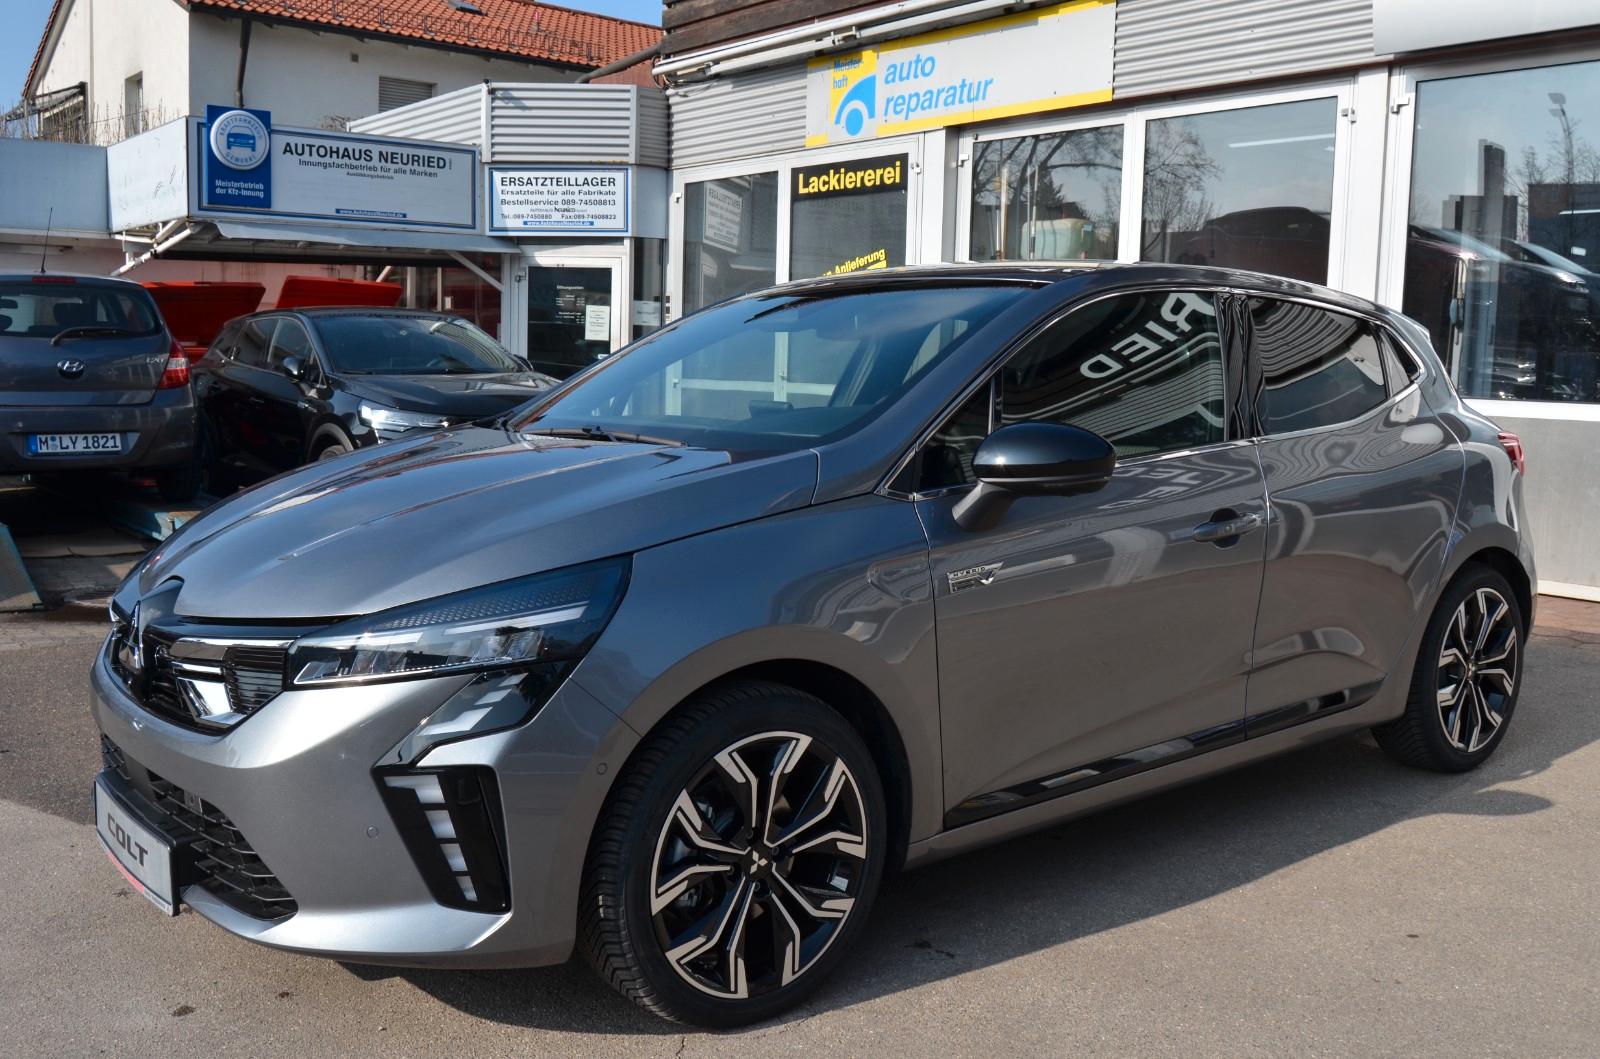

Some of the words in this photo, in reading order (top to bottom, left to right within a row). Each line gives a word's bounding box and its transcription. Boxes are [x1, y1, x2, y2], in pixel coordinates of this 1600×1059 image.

[884, 53, 936, 84] auto
[883, 78, 993, 120] reparatur
[282, 142, 373, 162] AUTOHAUS
[378, 150, 447, 169] NEURIED
[298, 158, 378, 173] Innungsfachbetrieb
[380, 165, 392, 173] für
[409, 168, 438, 178] Marken
[798, 160, 901, 195] Lackiererei
[215, 179, 264, 190] Meisterbetrieb
[227, 188, 264, 198] Kfz-Innung
[500, 176, 617, 187] ERSATZTEILLAGER
[500, 198, 559, 206] Bestellservice
[561, 198, 617, 206] 089-74508813
[834, 248, 885, 274] Anlieferung
[60, 435, 79, 451] LY
[82, 434, 120, 451] 1821
[108, 812, 148, 868] COLT
